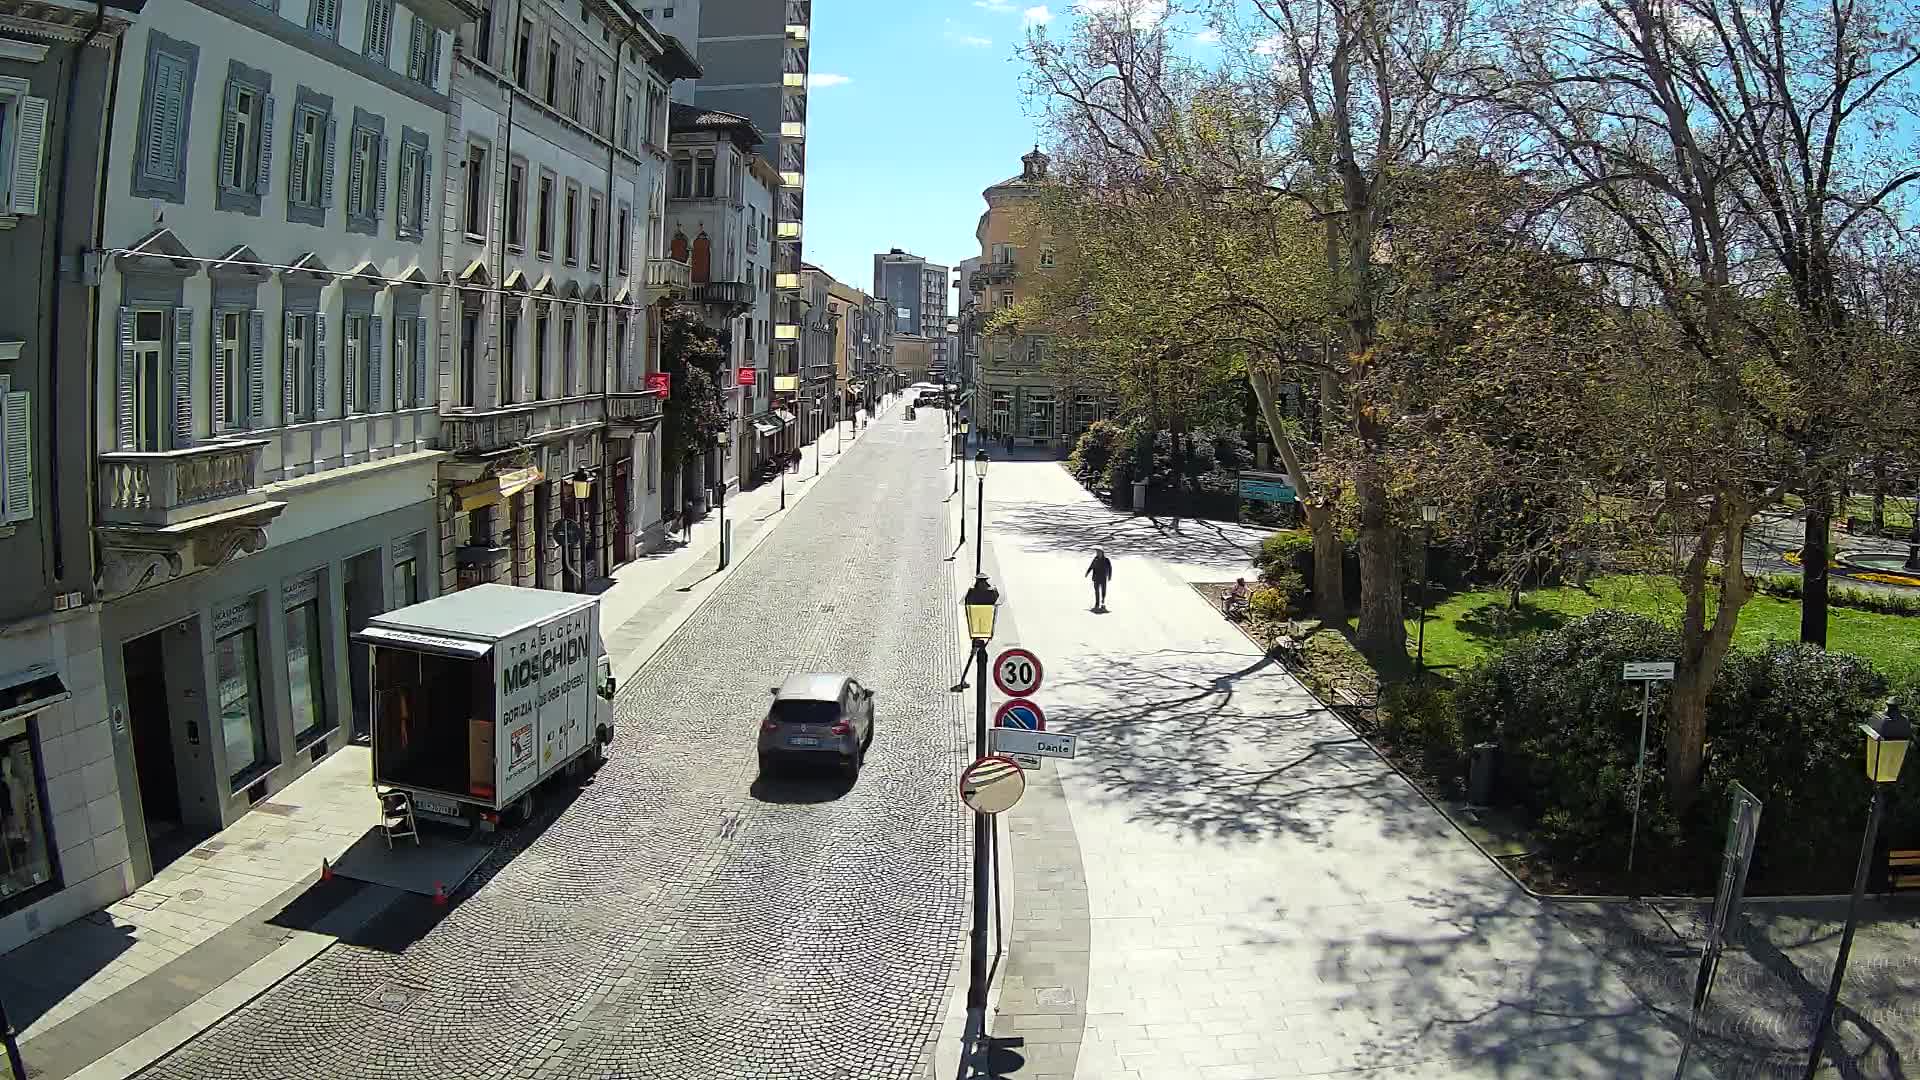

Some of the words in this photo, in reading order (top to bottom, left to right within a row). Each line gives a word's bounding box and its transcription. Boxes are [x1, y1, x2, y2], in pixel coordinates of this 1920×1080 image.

[510, 616, 586, 659] TRASLOCHI
[503, 632, 588, 696] MOSCHION
[1005, 662, 1032, 684] 30
[1038, 742, 1069, 753] Dante
